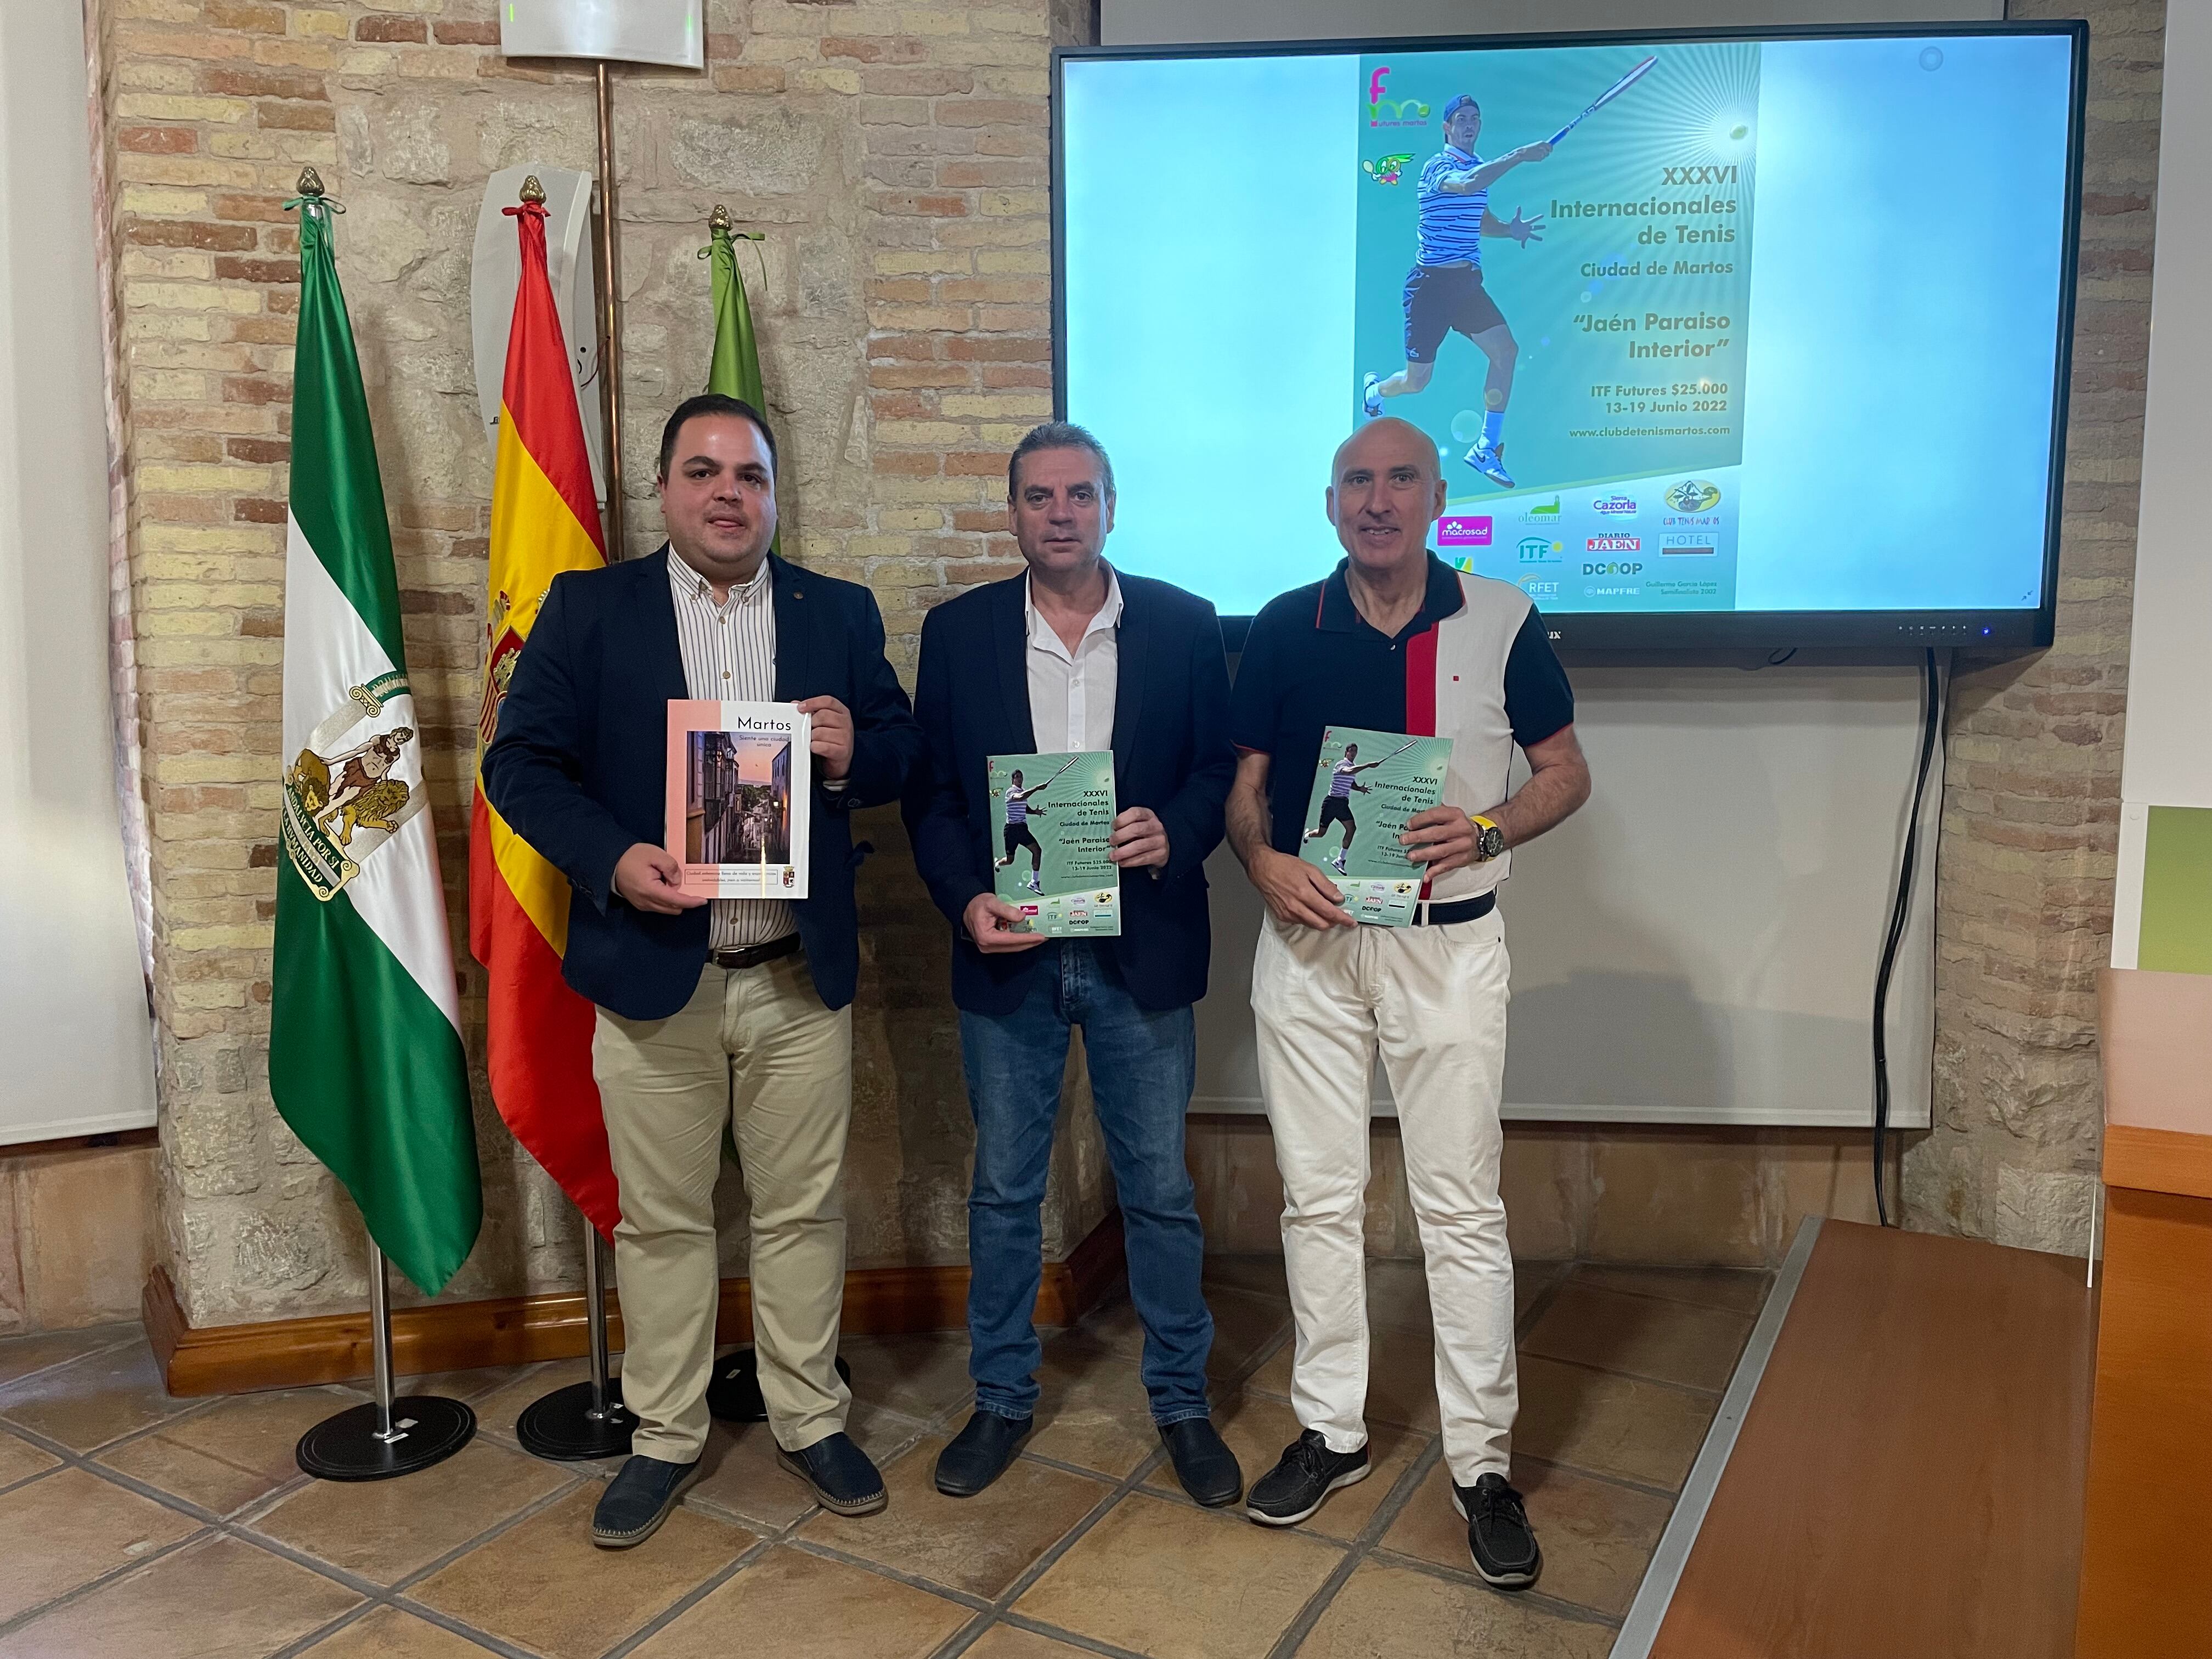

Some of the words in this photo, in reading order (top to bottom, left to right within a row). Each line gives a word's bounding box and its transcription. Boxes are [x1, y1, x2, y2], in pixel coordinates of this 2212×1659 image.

[1662, 165, 1737, 185] XXXVI
[1551, 194, 1737, 218] Internacionales
[1638, 225, 1667, 245] de
[1675, 224, 1735, 243] Tenis
[1581, 262, 1640, 276] Ciudad
[1646, 261, 1668, 275] de
[1673, 261, 1733, 274] Martos
[1645, 312, 1730, 330] Paraiso
[1592, 386, 1611, 397] ITF
[1616, 386, 1667, 396] Futures
[1672, 383, 1728, 396] $25.000
[1606, 402, 1646, 414] 13-19
[1650, 401, 1688, 413] Junio
[1692, 400, 1728, 412] 2022
[1570, 426, 1730, 437] www.clubdetenismartos.com
[1593, 499, 1637, 510] Cazorla
[1519, 512, 1562, 522] oleomar
[1696, 517, 1720, 525] MAROS
[1442, 527, 1488, 535] macrosad
[1589, 539, 1639, 551] JAEN
[1666, 535, 1711, 545] HOTEL
[1520, 545, 1549, 559] ITF
[1529, 582, 1559, 593] RFET
[738, 716, 791, 730] Martos
[1412, 776, 1438, 785] XXXVI
[1374, 781, 1436, 795] Internacionales
[1048, 799, 1109, 808] Internacionales
[1414, 796, 1434, 804] Tenis
[312, 837, 332, 861] POR
[329, 856, 340, 869] SI
